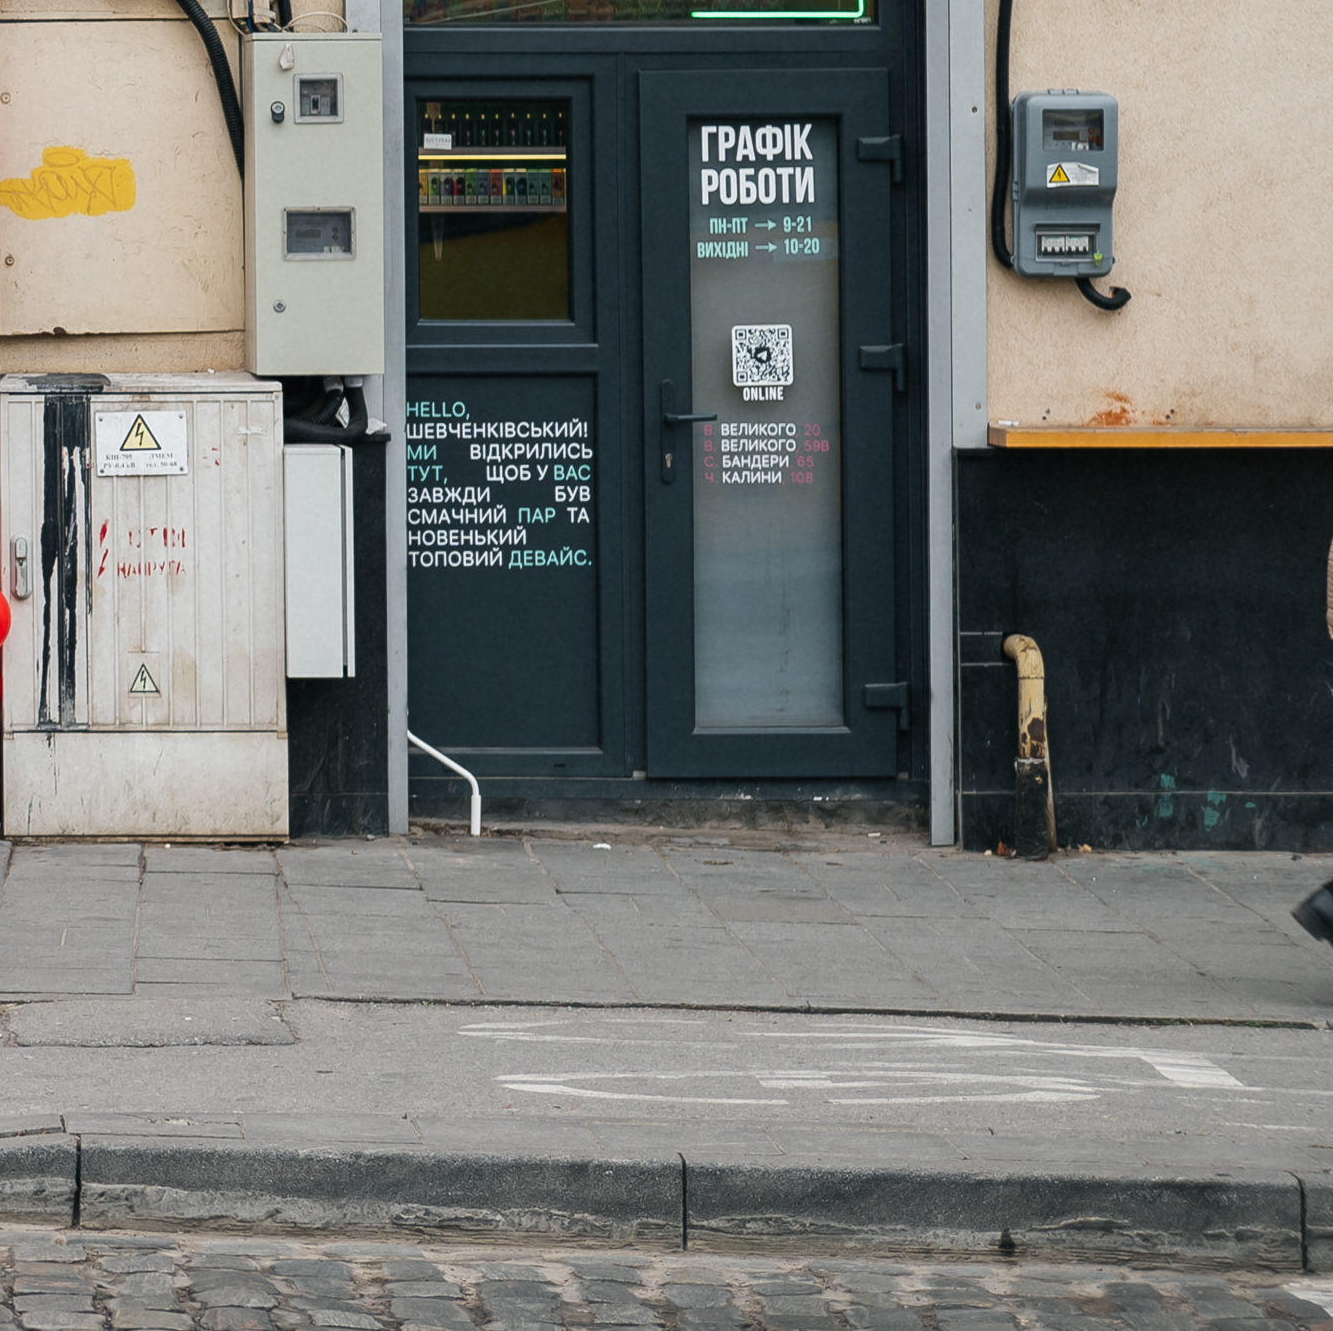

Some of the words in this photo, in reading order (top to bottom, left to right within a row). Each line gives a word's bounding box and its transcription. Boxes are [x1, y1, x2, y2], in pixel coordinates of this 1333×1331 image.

[701, 124, 813, 162] ГРАФІК
[701, 166, 815, 205] РОБОТИ
[709, 217, 748, 234] ПН-ПТ
[783, 216, 812, 233] 9-21
[697, 241, 749, 259] ВИХІДНІ
[784, 237, 820, 255] 10-20
[742, 387, 784, 401] ONLINE
[406, 401, 470, 421] HELLO,
[407, 418, 588, 439] ШЕВЧЕНКІВСЬКИЙ!
[704, 424, 716, 436] В.
[720, 423, 799, 438] ВЕЛИКОГО,
[804, 424, 821, 436] 20
[407, 445, 437, 460] МИ
[470, 443, 593, 462] ВІДКРИЛИСЬ
[704, 440, 716, 452] В.
[721, 439, 799, 453] ВЕЛИКОГО,
[804, 440, 830, 452] 59В
[704, 456, 718, 468] С.
[722, 455, 793, 470] БАНДЕРИ,
[797, 456, 814, 468] 65
[407, 465, 448, 484] ТУТ,
[486, 465, 531, 484] ЩОБ
[537, 465, 549, 481] У
[553, 465, 591, 481] ВАС
[705, 472, 718, 484] Ч.
[722, 471, 785, 485] КАЛИНИ,
[790, 472, 813, 484] 108
[408, 487, 490, 506] ЗАВЖДИ
[555, 486, 591, 502] БУВ
[408, 505, 507, 525] СМАЧНИЙ
[518, 507, 556, 523] ПАР
[567, 507, 590, 523] ТА
[408, 526, 527, 546] НОВЕНЬКИЙ
[408, 547, 503, 567] ТОПОВИЙ
[508, 546, 592, 569] ДЕВАЙС.
